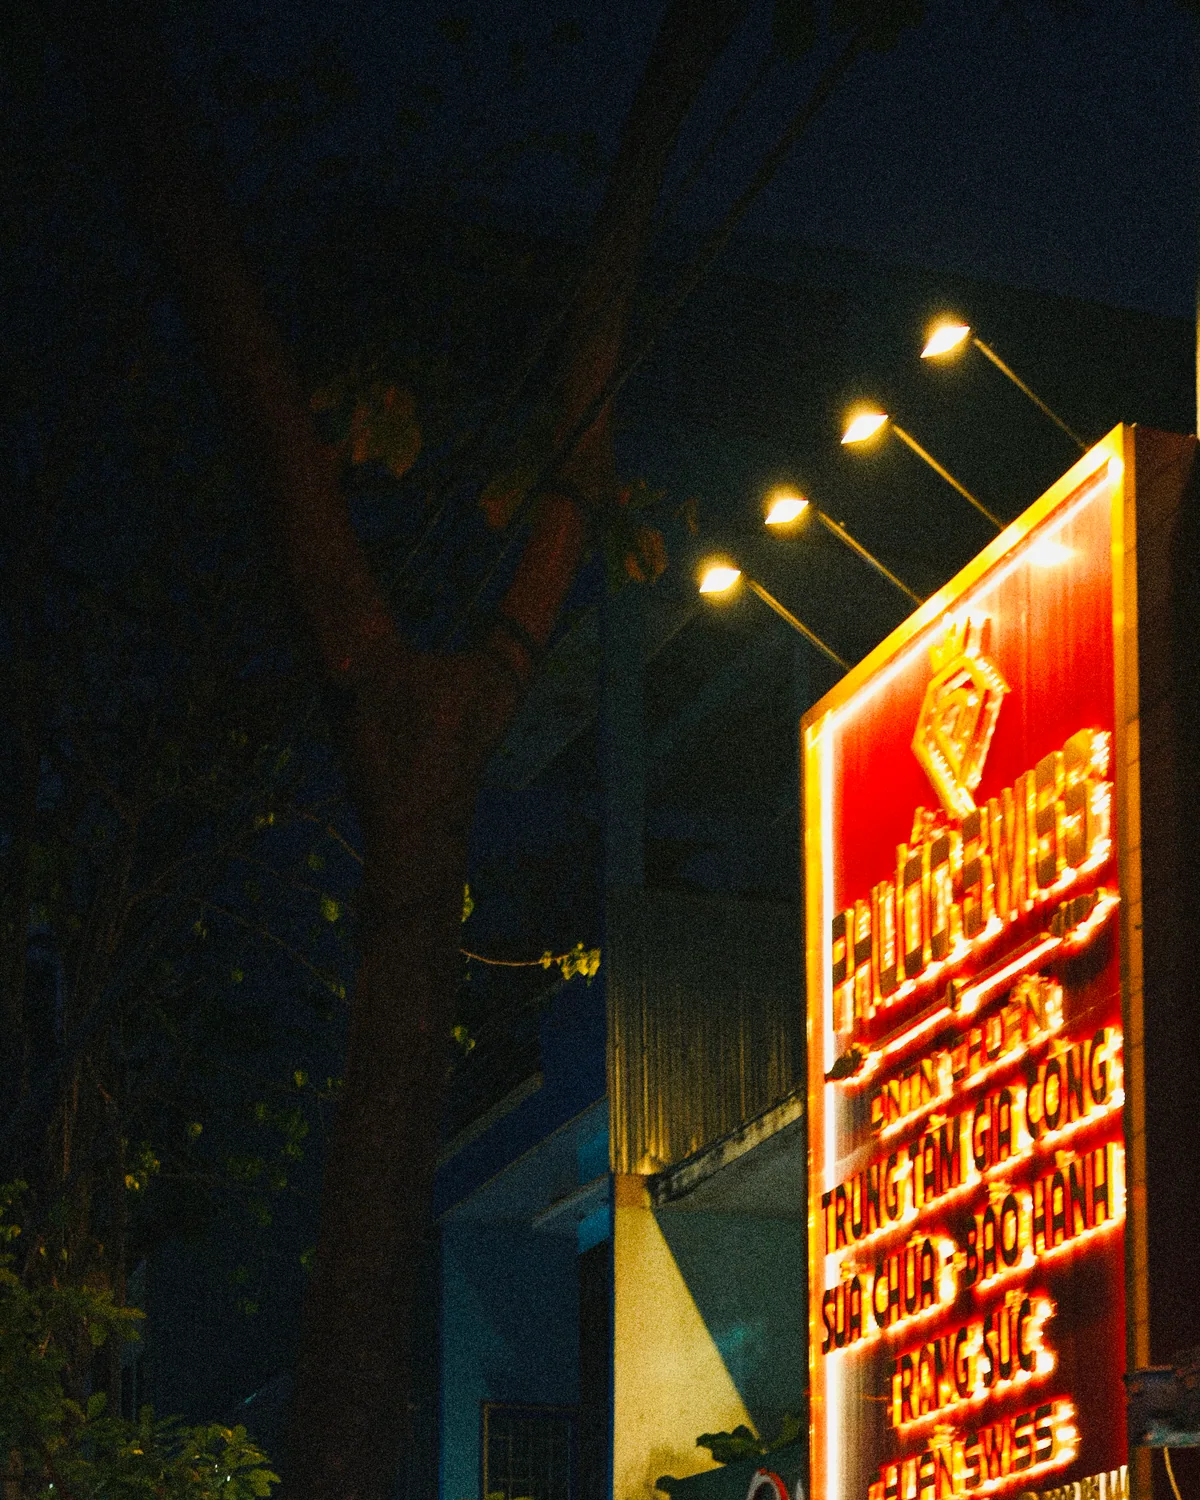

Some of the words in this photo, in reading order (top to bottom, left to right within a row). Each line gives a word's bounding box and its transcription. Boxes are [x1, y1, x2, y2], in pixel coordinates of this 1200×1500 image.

[961, 728, 1113, 938] SWISS
[821, 1152, 911, 1255] TRUNG
[909, 1112, 973, 1208] TÂM
[972, 1084, 1027, 1172] GIA
[1026, 1028, 1122, 1140] CÔNG
[1032, 1142, 1124, 1254] HÀNH
[889, 1324, 982, 1427] TRANG
[961, 1401, 1062, 1490] SWISS
